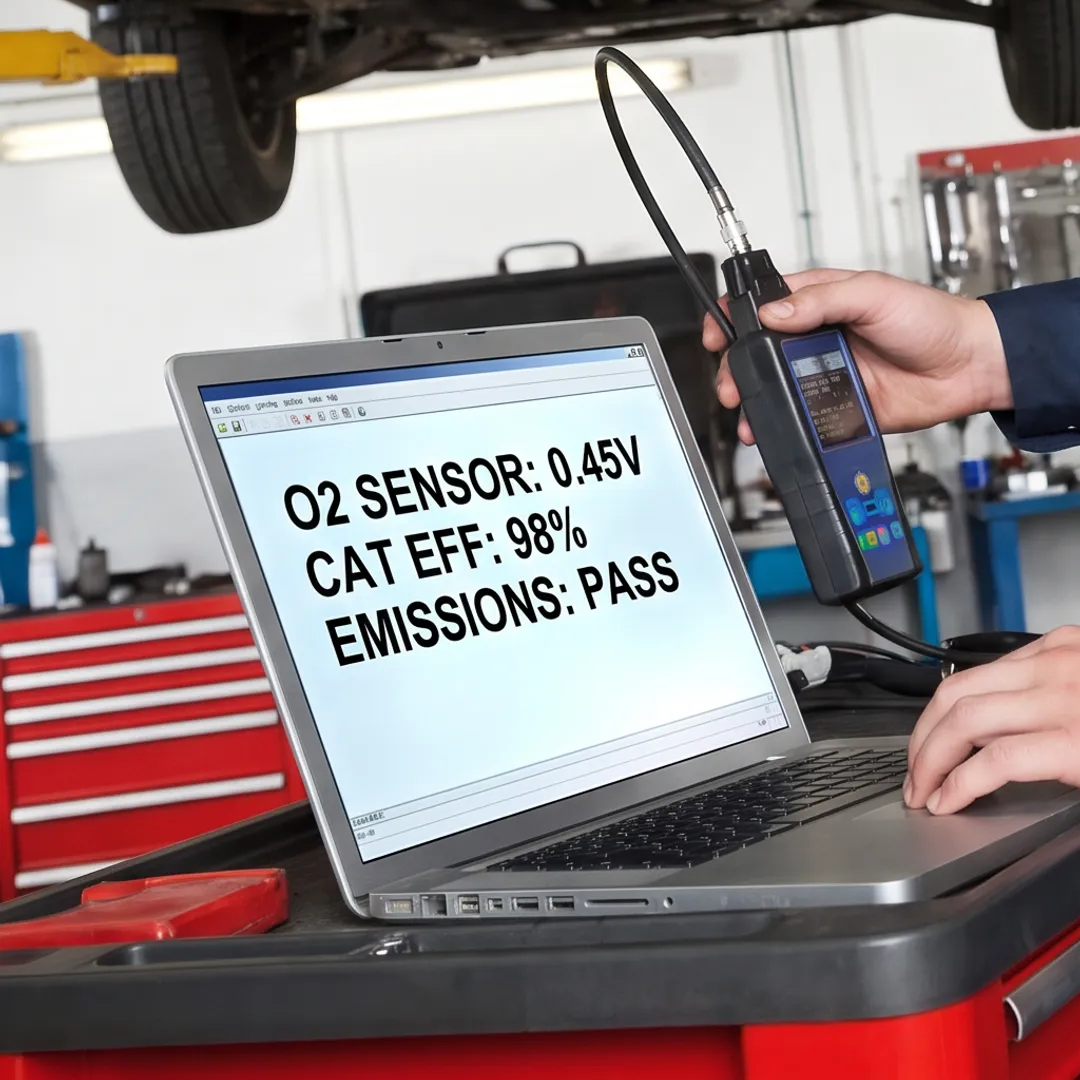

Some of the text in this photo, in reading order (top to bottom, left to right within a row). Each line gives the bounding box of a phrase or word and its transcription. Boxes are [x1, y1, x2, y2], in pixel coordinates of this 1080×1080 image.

[284, 434, 641, 531] O2 SENSOR: 0.45V
[306, 505, 589, 598] CAT EFF: 98%
[325, 551, 679, 667] EMISSIONS: PASS
